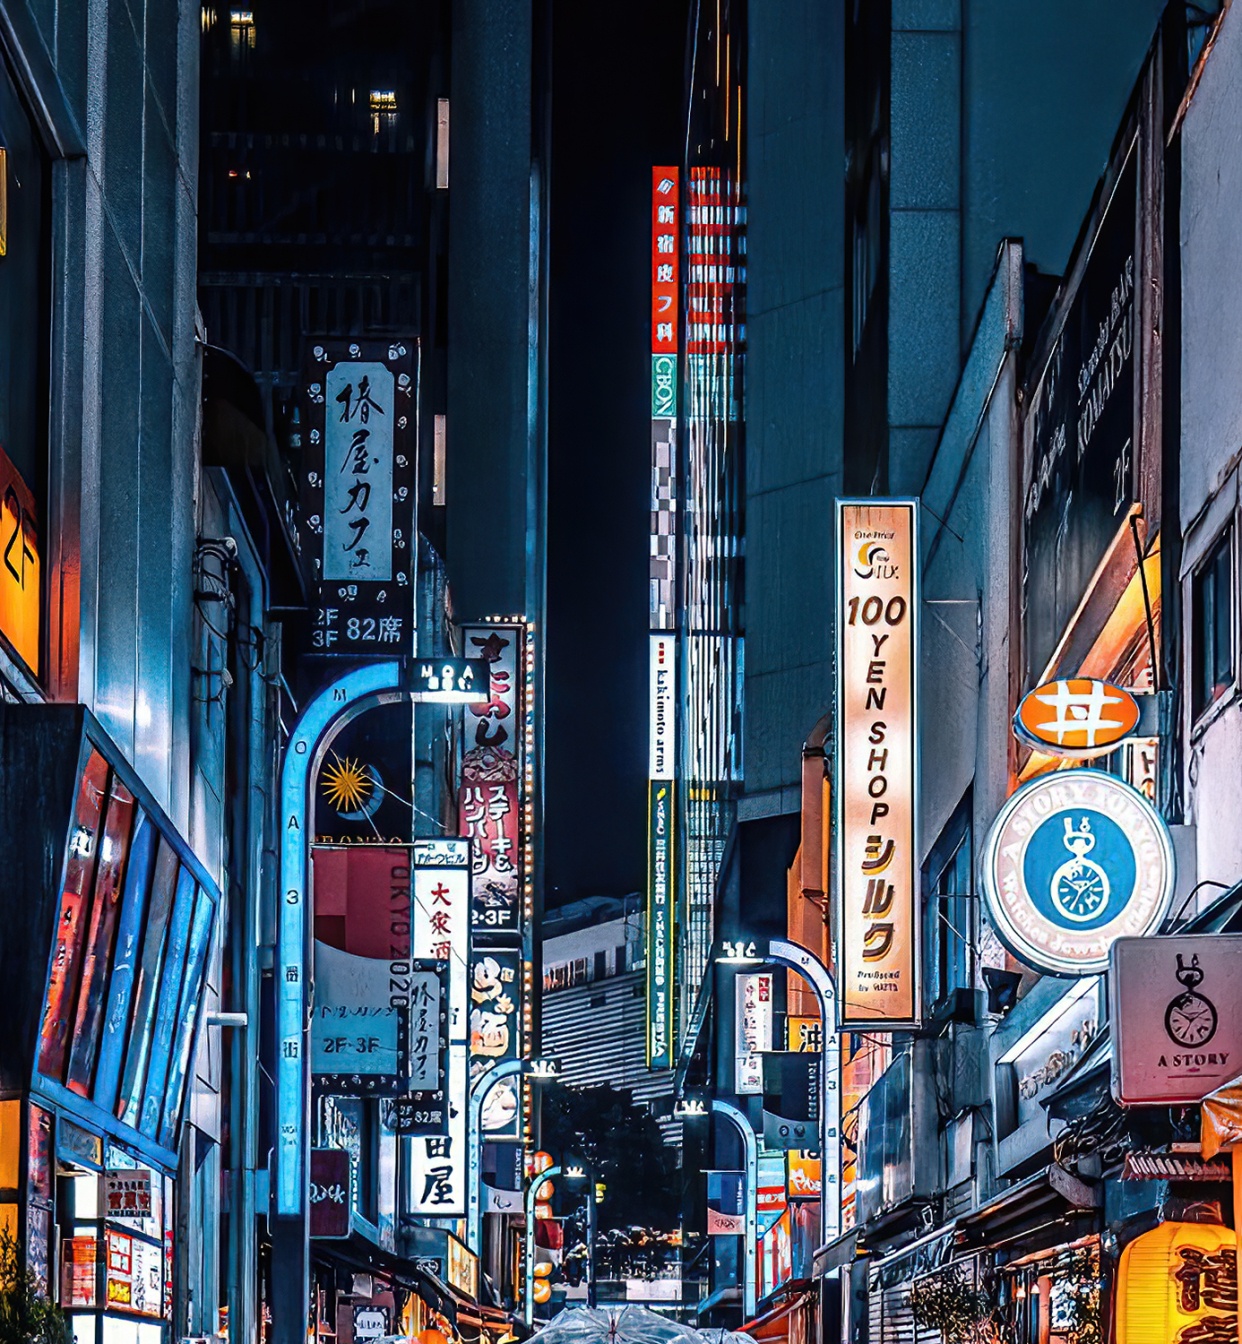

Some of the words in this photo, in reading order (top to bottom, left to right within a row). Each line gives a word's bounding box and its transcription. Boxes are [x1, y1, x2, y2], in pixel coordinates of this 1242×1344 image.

[335, 376, 385, 568] 椿屋カフェ
[848, 596, 906, 627] 100
[421, 665, 474, 679] MOA
[865, 633, 889, 711] YEN
[867, 721, 889, 826] SHOP
[861, 835, 896, 962] シルク
[1157, 1055, 1168, 1067] A
[1173, 1053, 1231, 1067] STORY
